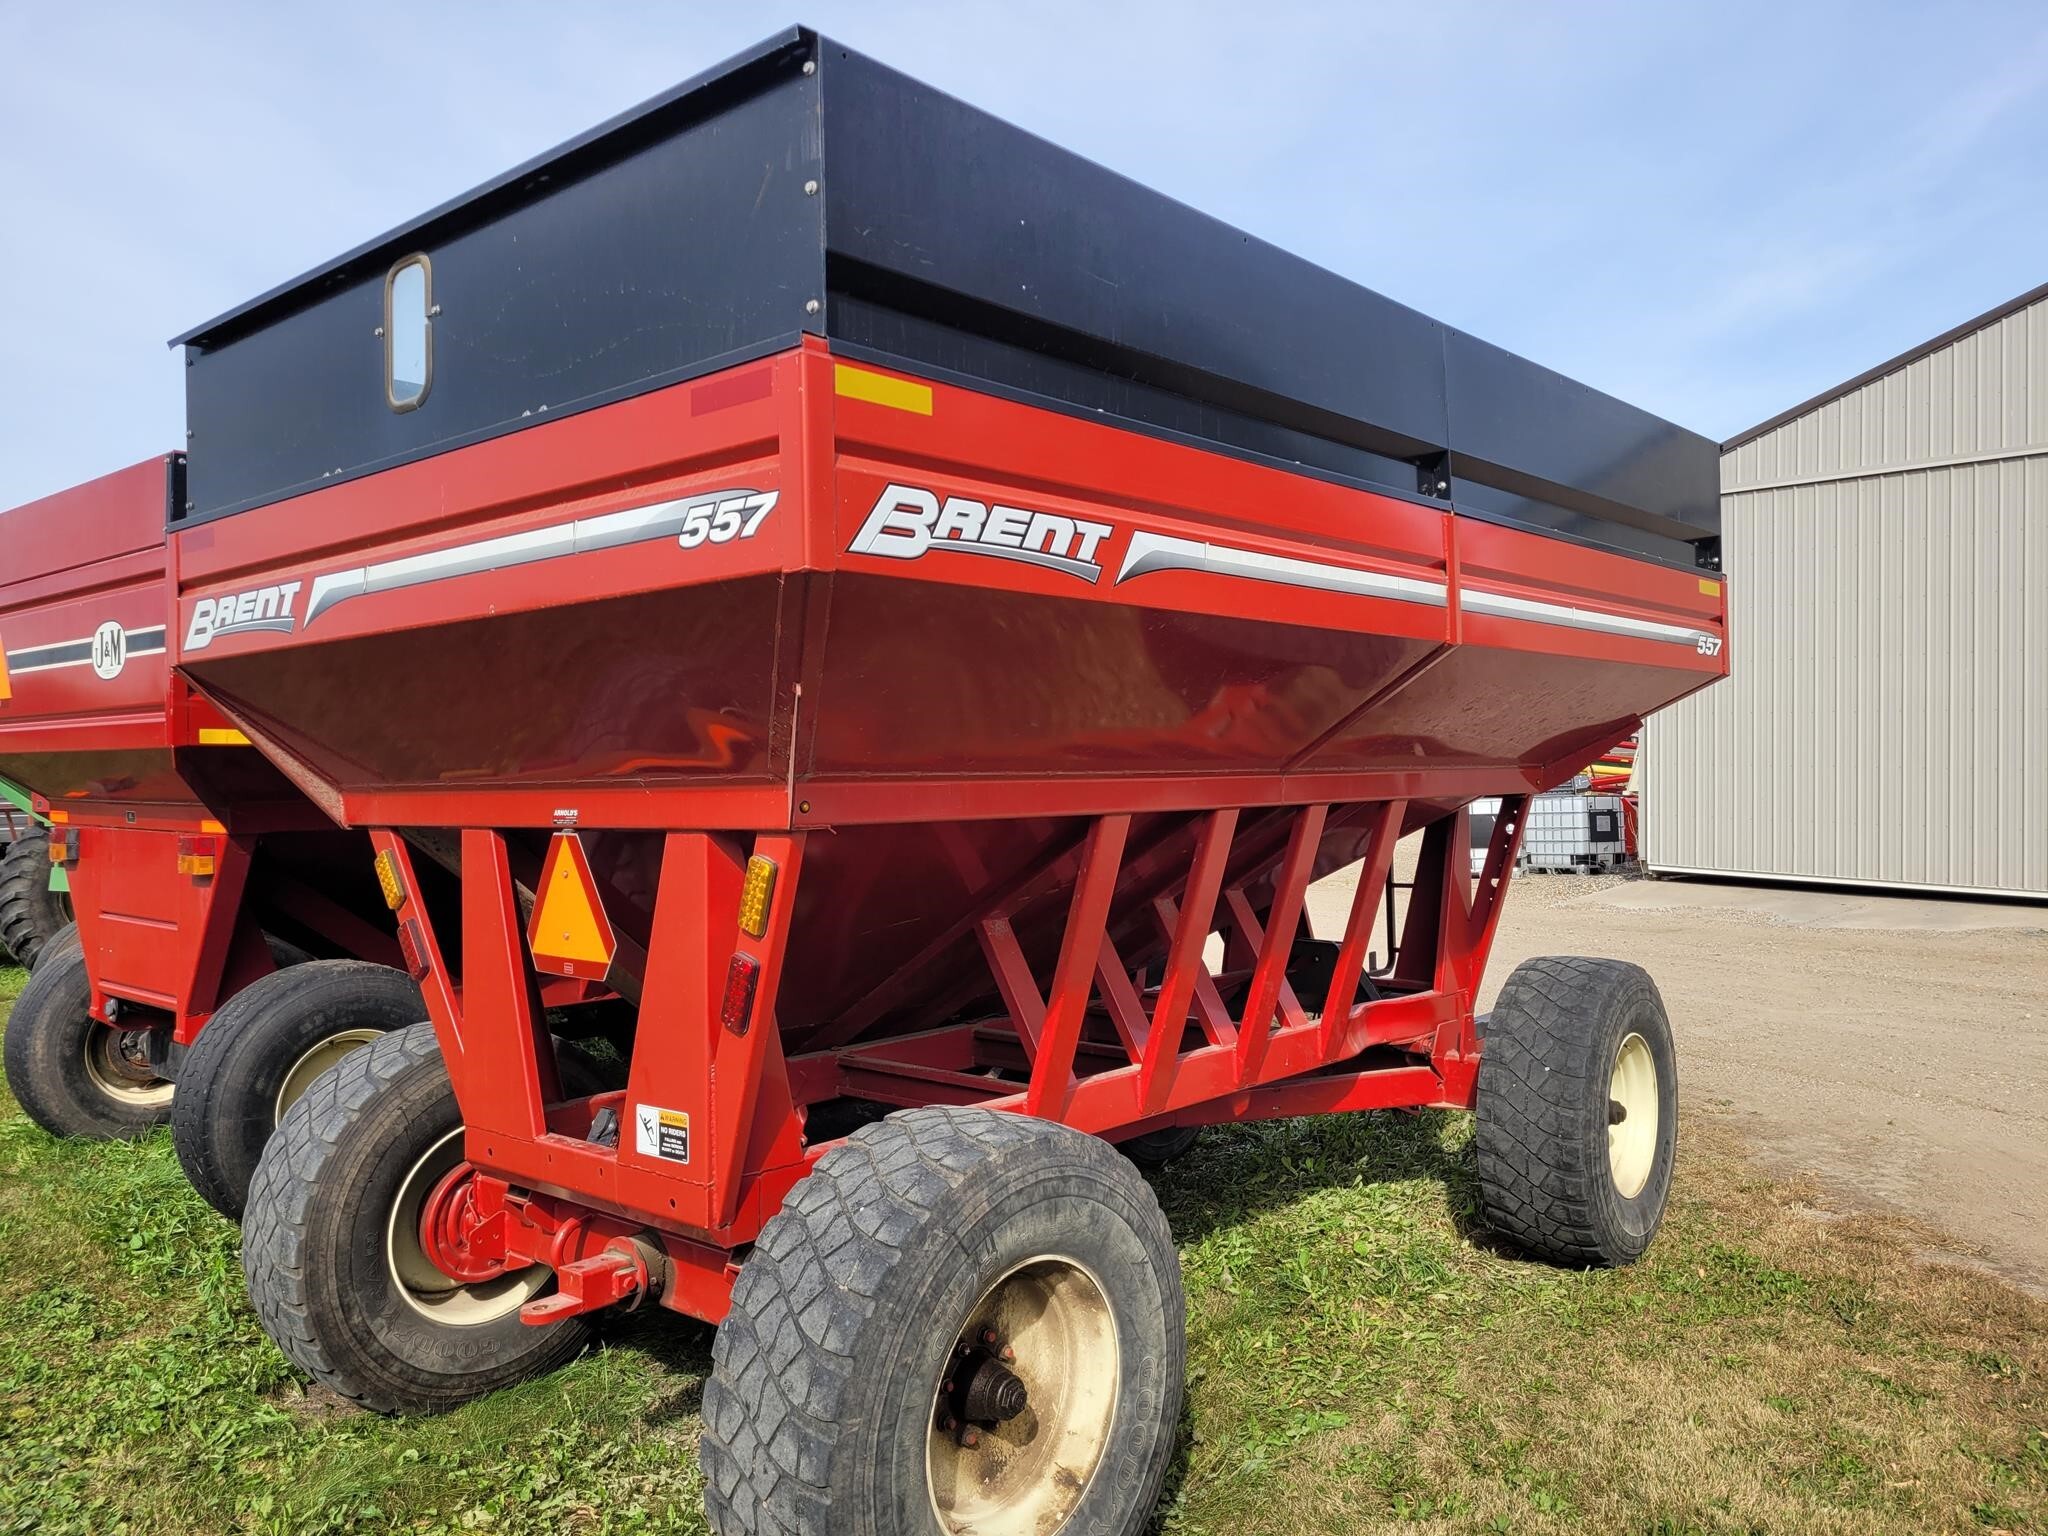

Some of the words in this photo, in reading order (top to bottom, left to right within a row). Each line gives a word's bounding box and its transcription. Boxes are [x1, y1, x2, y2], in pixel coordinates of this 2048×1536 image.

[678, 489, 780, 549] 557
[95, 628, 122, 669] J&M
[1696, 635, 1723, 656] 557
[660, 1126, 668, 1134] NO
[668, 1127, 686, 1138] RIDERS
